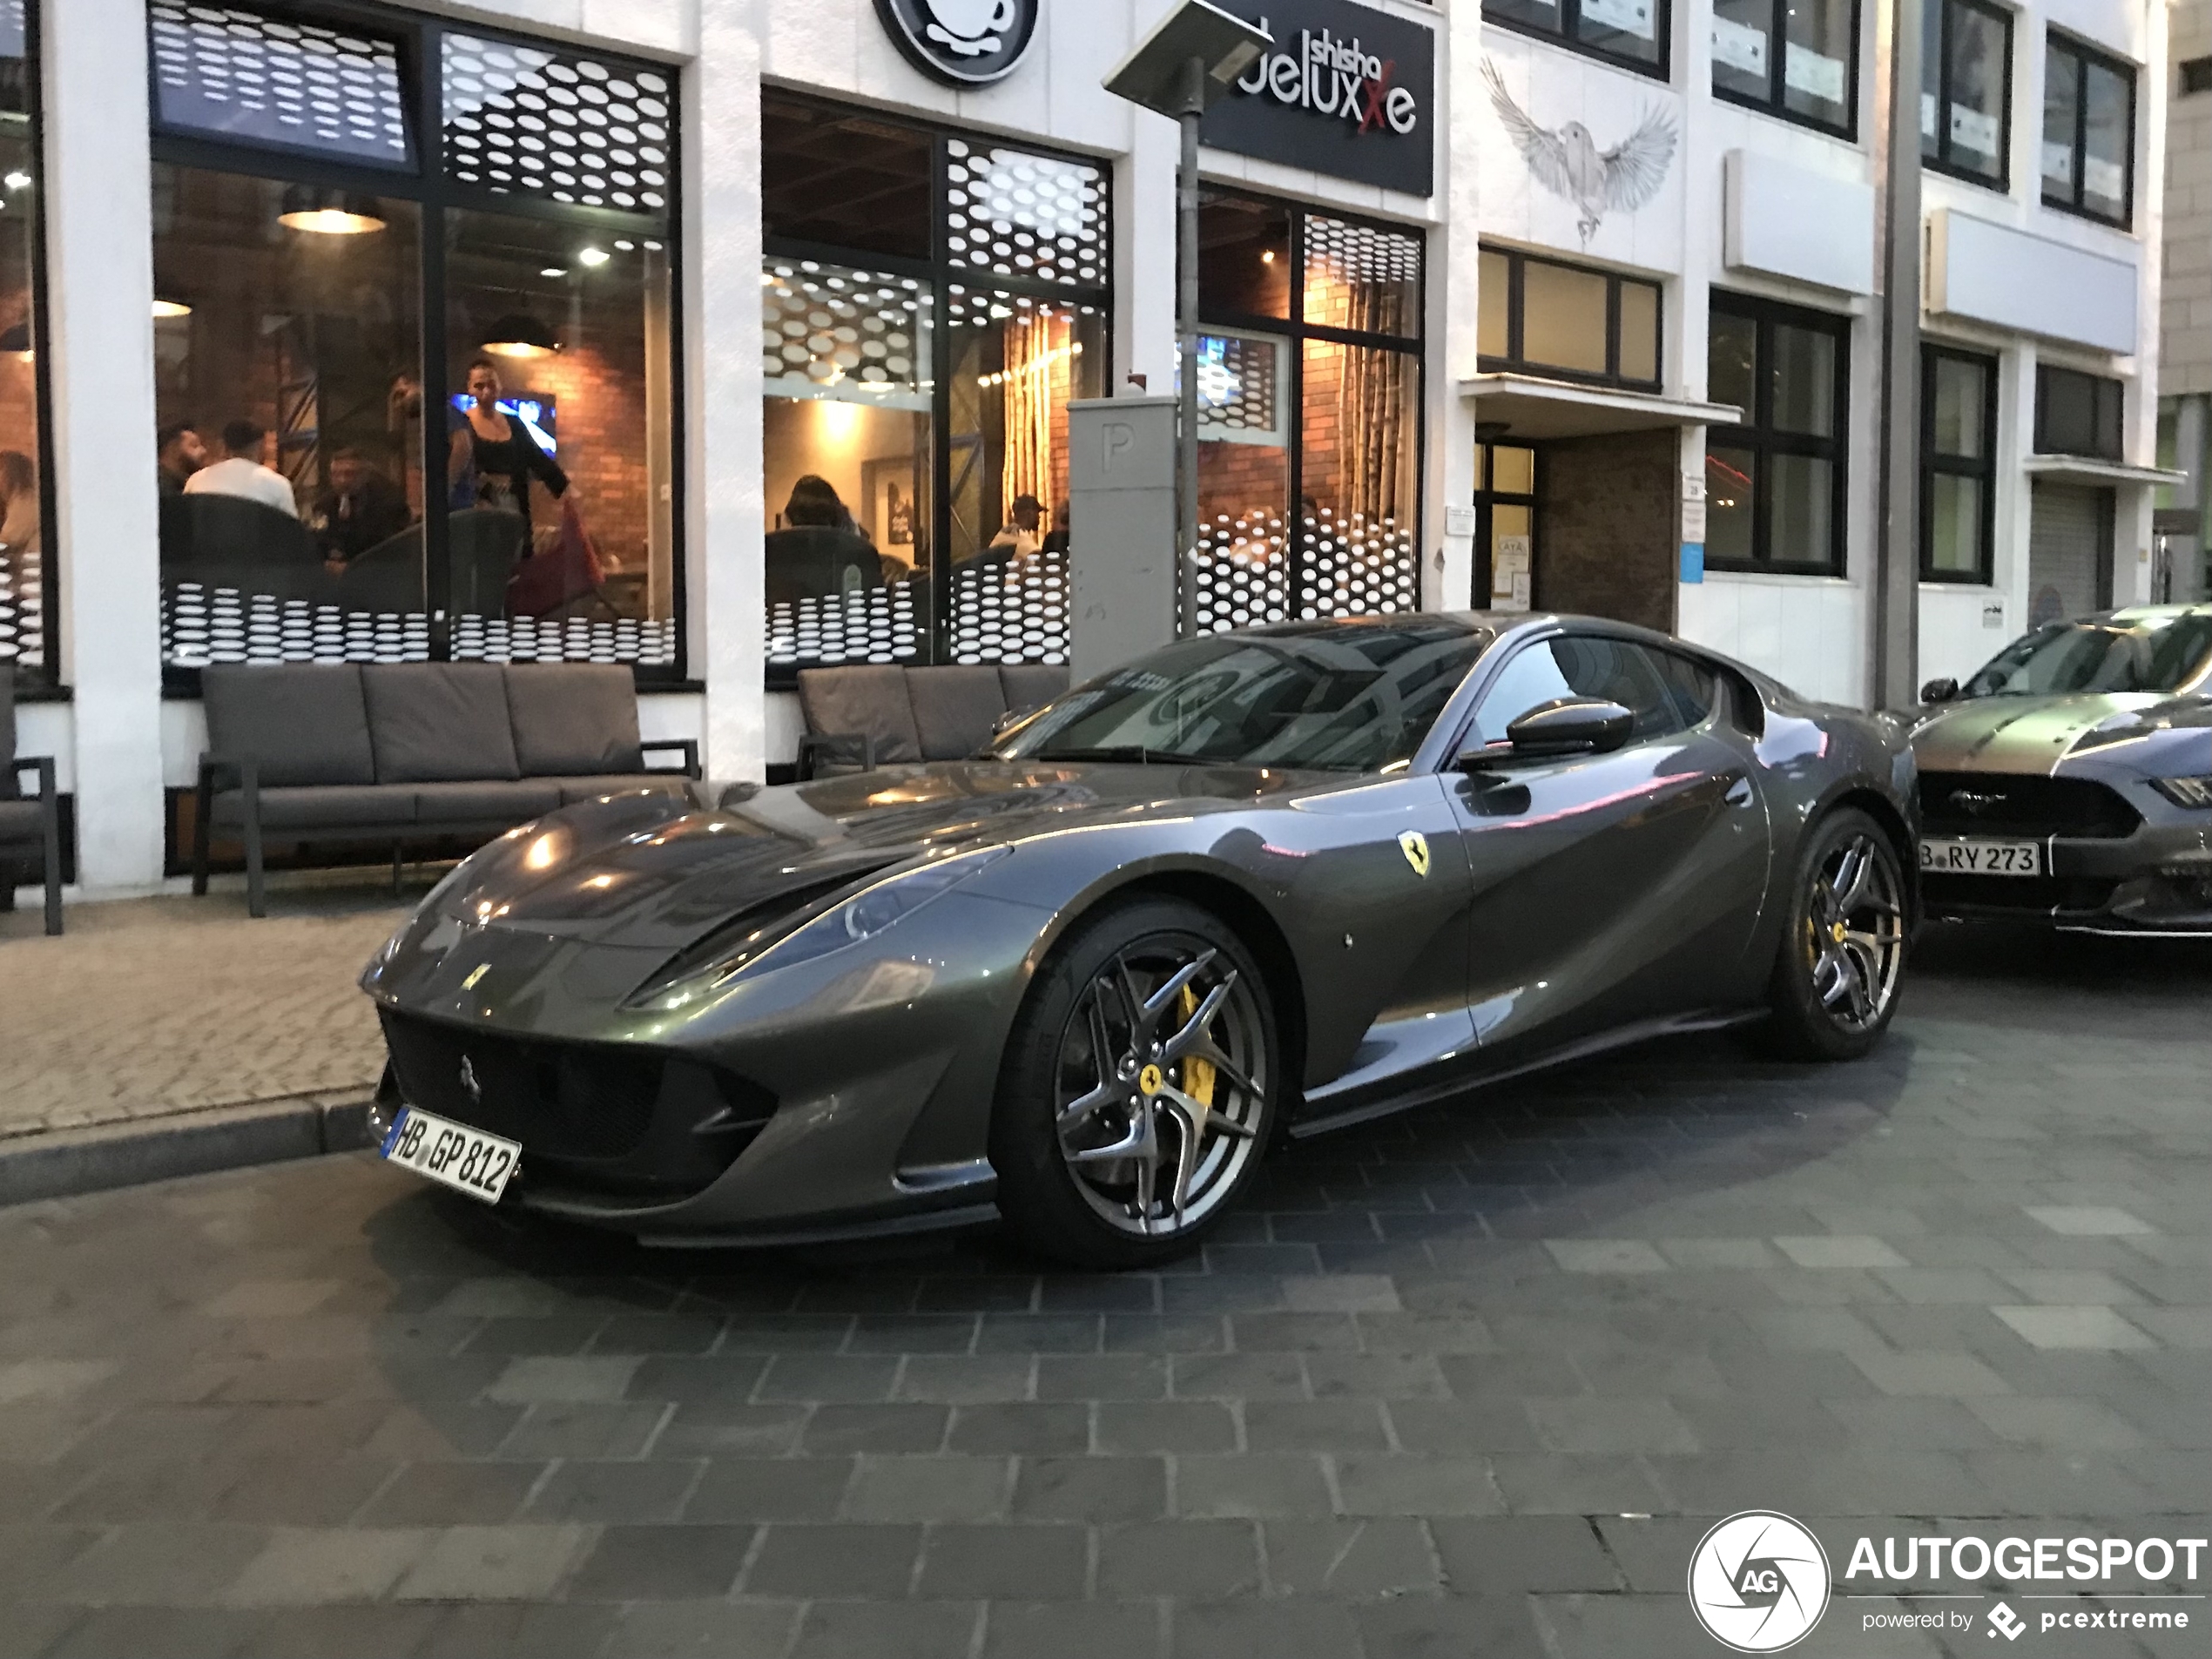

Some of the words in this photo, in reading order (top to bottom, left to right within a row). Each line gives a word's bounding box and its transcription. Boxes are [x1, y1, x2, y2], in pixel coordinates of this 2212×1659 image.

[1309, 28, 1382, 82] shisha
[1101, 421, 1136, 474] P
[1920, 844, 1933, 867] B
[1948, 846, 1979, 869] RY
[1986, 847, 2033, 871] 273
[392, 1116, 428, 1159] HB
[428, 1128, 467, 1173] GP
[458, 1138, 512, 1193] 812
